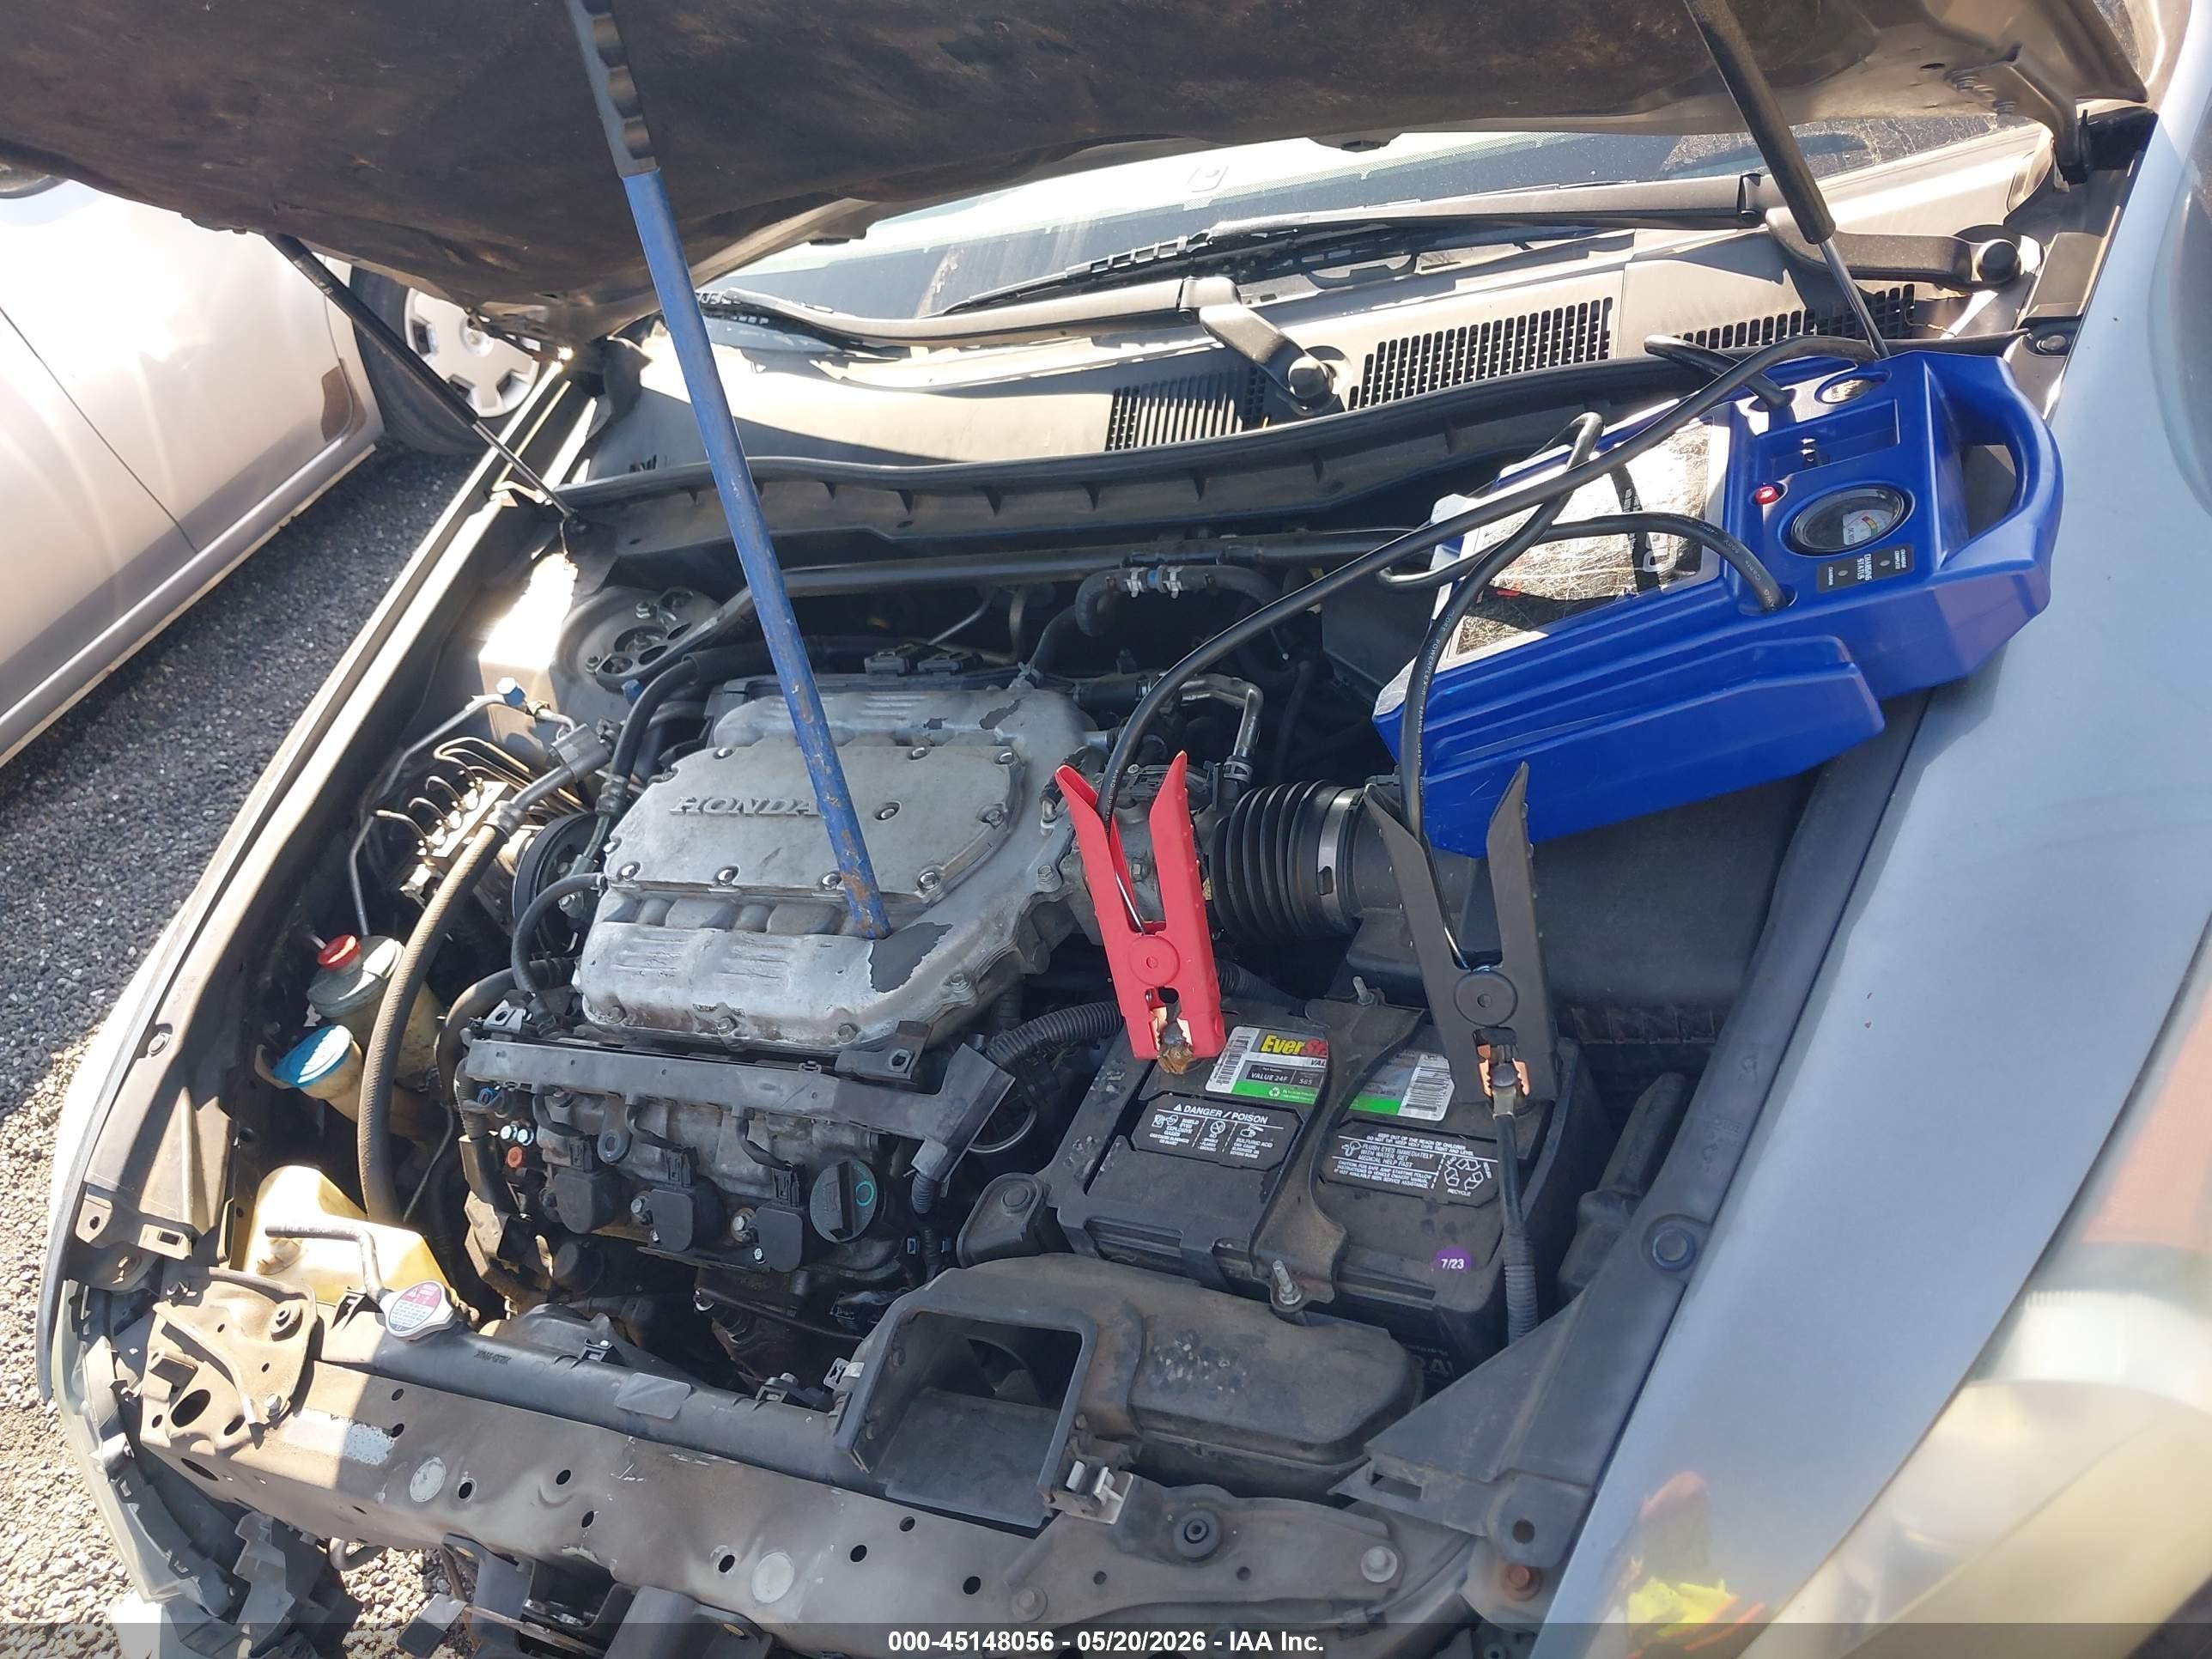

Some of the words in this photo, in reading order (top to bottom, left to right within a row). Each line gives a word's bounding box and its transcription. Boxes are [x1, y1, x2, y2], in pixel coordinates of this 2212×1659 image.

[670, 795, 820, 817] HONDA
[1250, 1072, 1273, 1081] VALUE
[1274, 1074, 1288, 1083] 24F
[1183, 1105, 1223, 1117] DANGER
[1231, 1112, 1268, 1124] POISON
[1358, 1154, 1381, 1163] MEDICAL
[1396, 1148, 1434, 1159] IMMEDIATELY
[1447, 1188, 1472, 1197] RECYCLE
[1441, 1258, 1465, 1270] 7/23
